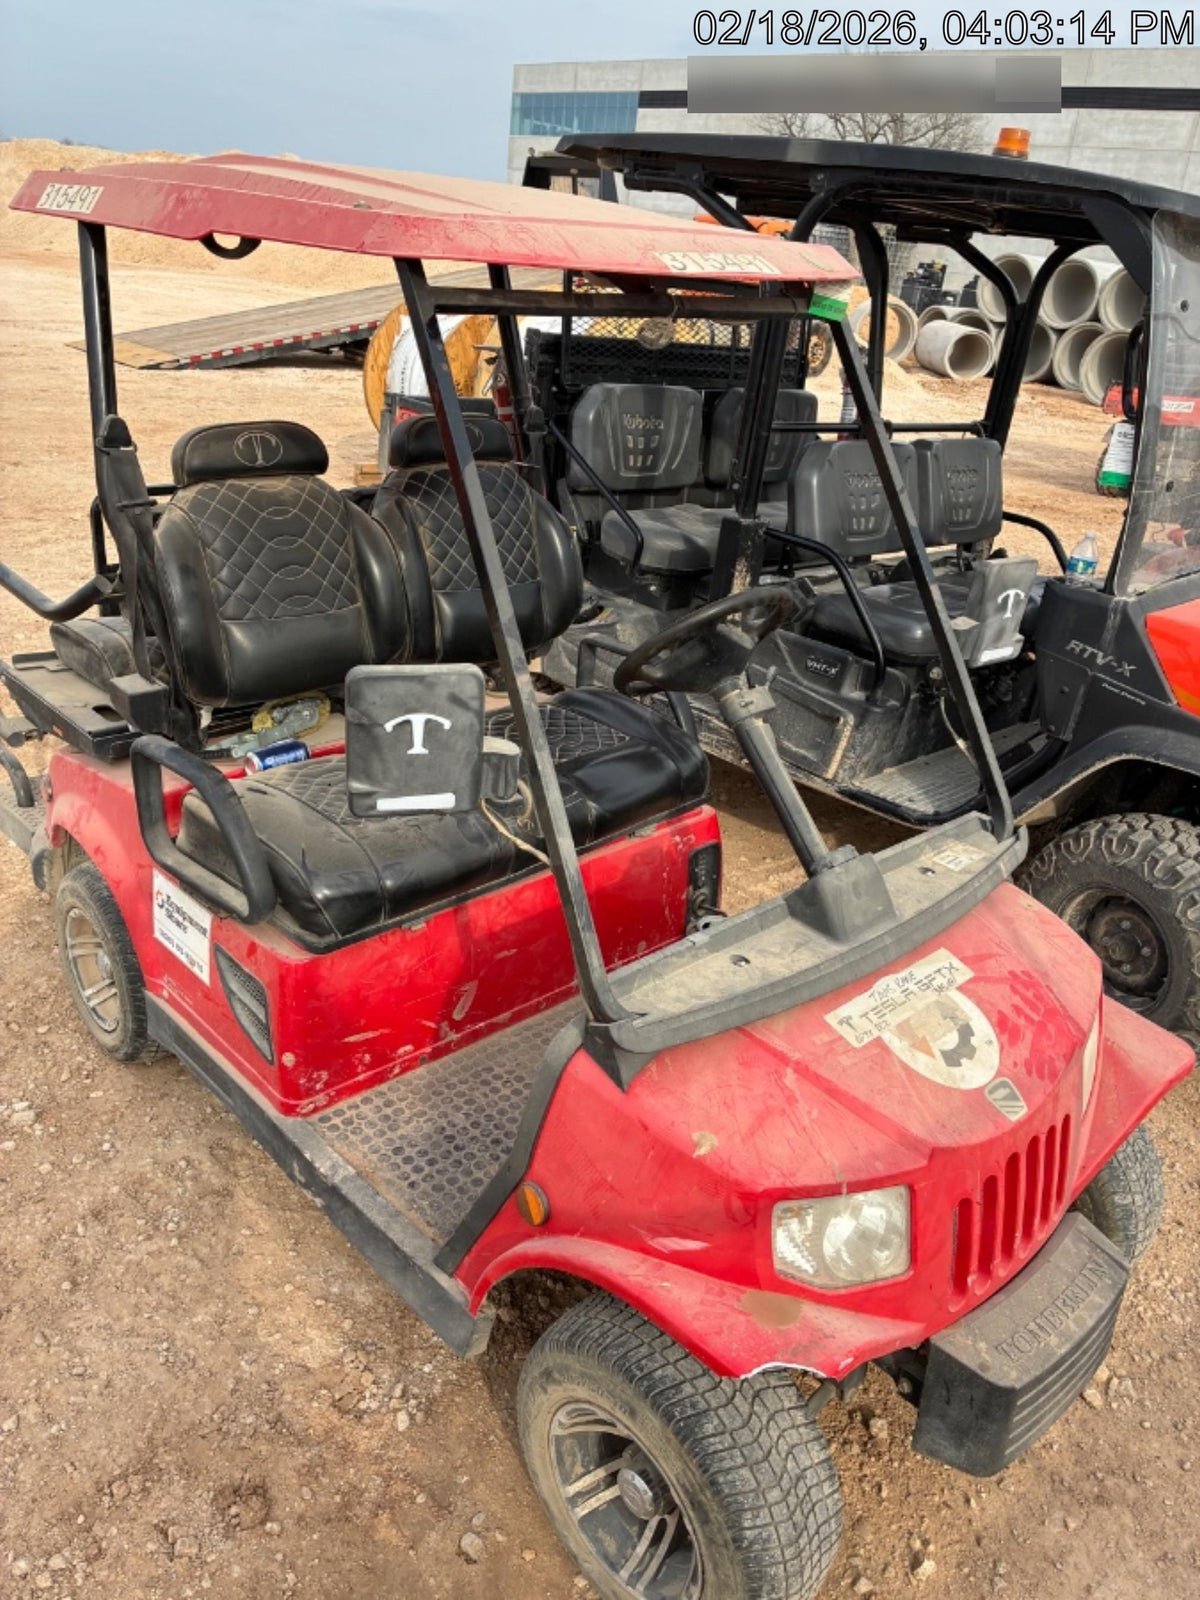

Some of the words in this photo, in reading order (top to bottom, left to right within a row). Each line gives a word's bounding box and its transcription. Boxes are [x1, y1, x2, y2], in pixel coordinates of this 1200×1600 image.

[39, 184, 100, 211] 315491
[663, 252, 776, 273] 315491
[622, 413, 664, 430] Kubota
[1064, 639, 1137, 677] RTV-X
[860, 988, 917, 1024] TESLA
[996, 1260, 1109, 1362] TOMBERLIN
